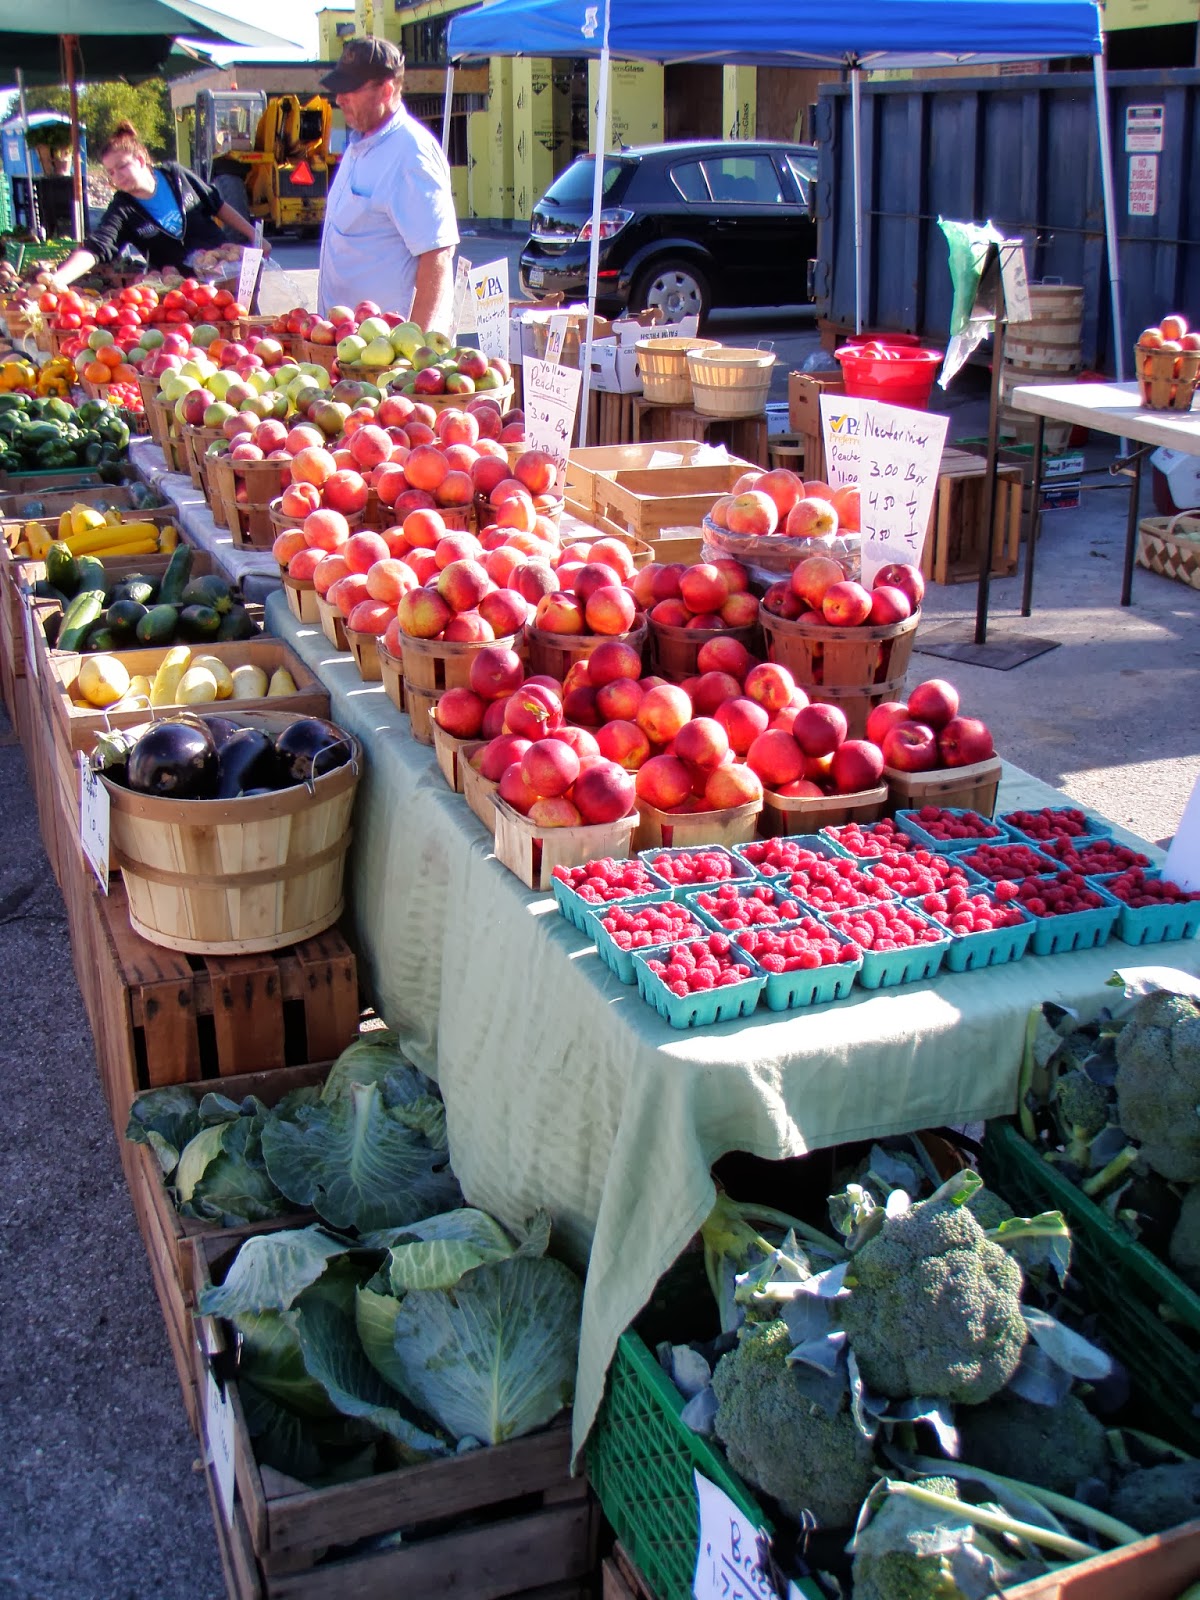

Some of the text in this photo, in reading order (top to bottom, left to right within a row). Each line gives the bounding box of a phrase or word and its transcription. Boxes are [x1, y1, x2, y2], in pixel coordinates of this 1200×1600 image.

[1131, 202, 1151, 213] FINE
[487, 276, 504, 297] PA
[539, 362, 567, 378] Yellow
[530, 366, 570, 398] Peaches
[869, 460, 928, 486] 3.00 Box
